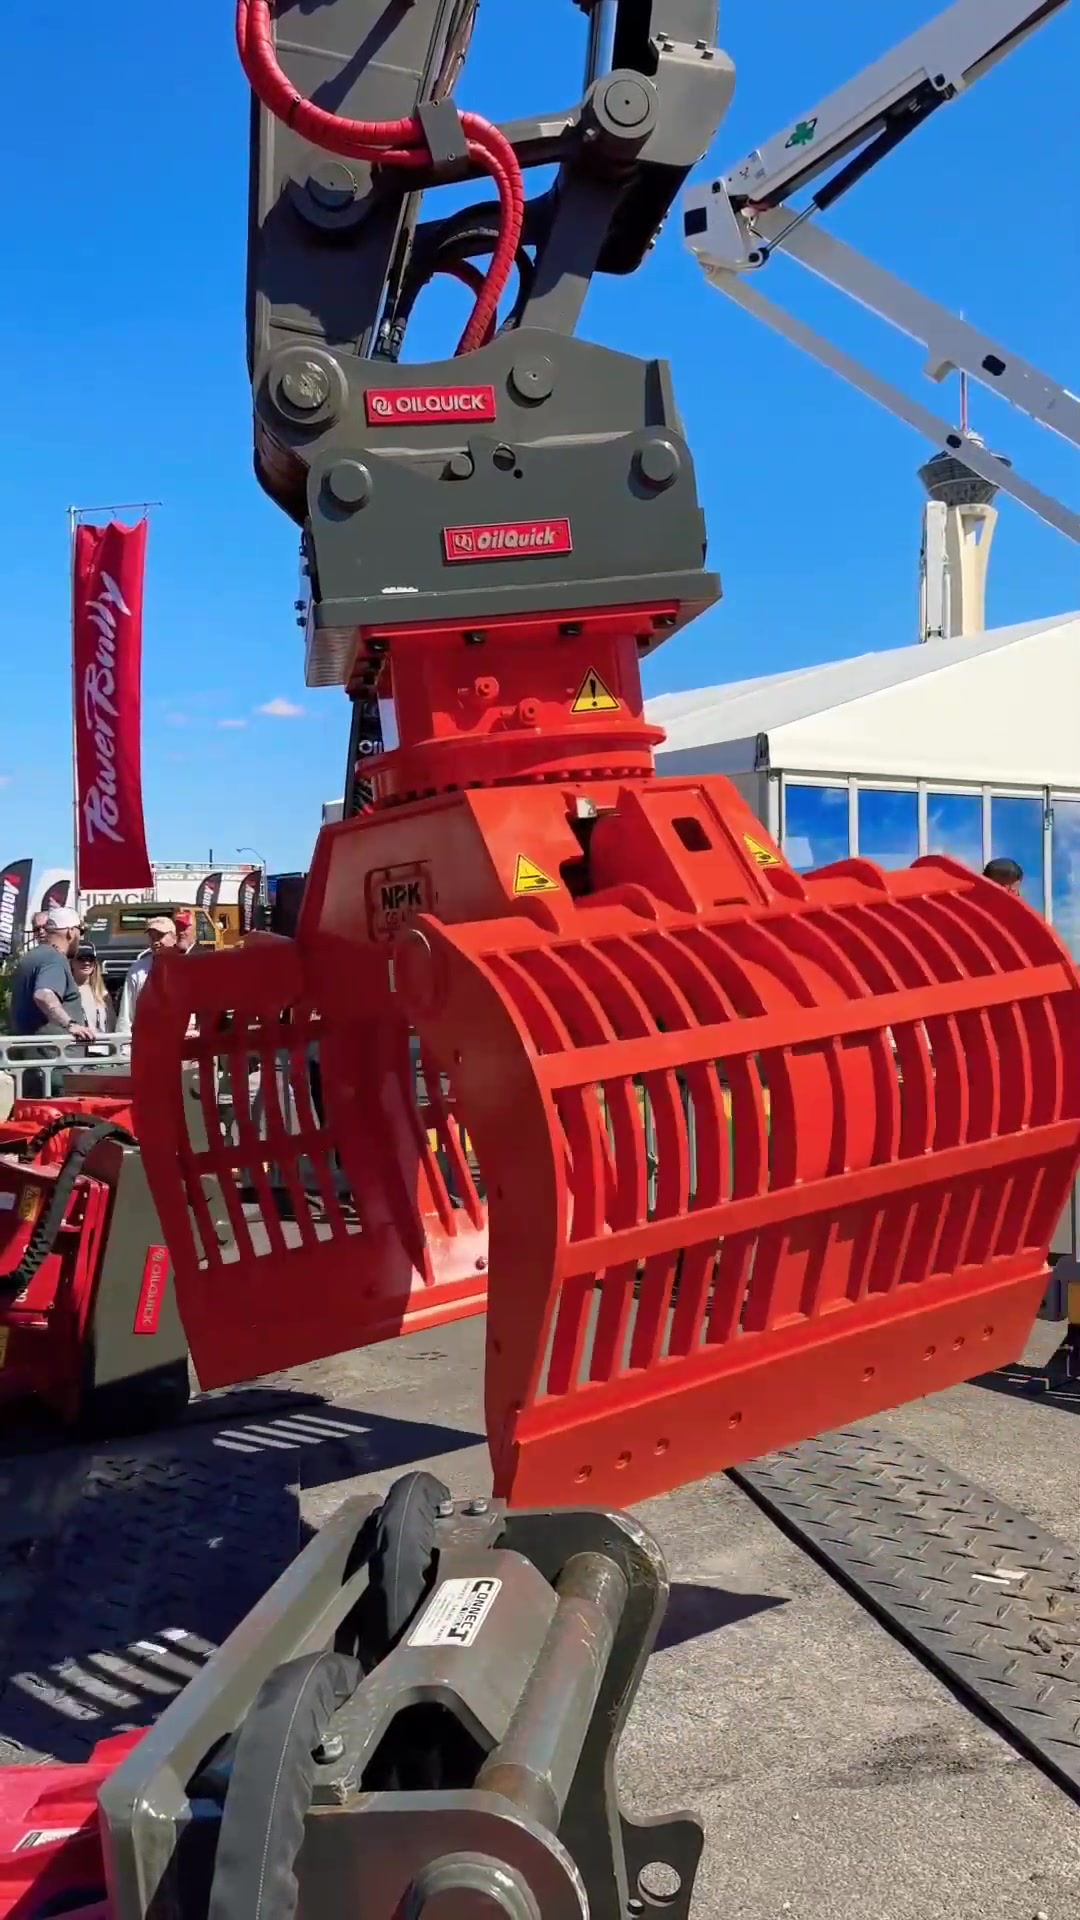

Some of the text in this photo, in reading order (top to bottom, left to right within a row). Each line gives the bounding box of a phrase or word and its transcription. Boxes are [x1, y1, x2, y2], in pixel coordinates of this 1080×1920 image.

[396, 394, 486, 413] OILQUICK
[477, 526, 555, 550] OilQuick
[381, 881, 422, 911] NPK
[446, 1580, 495, 1642] CONNECT
